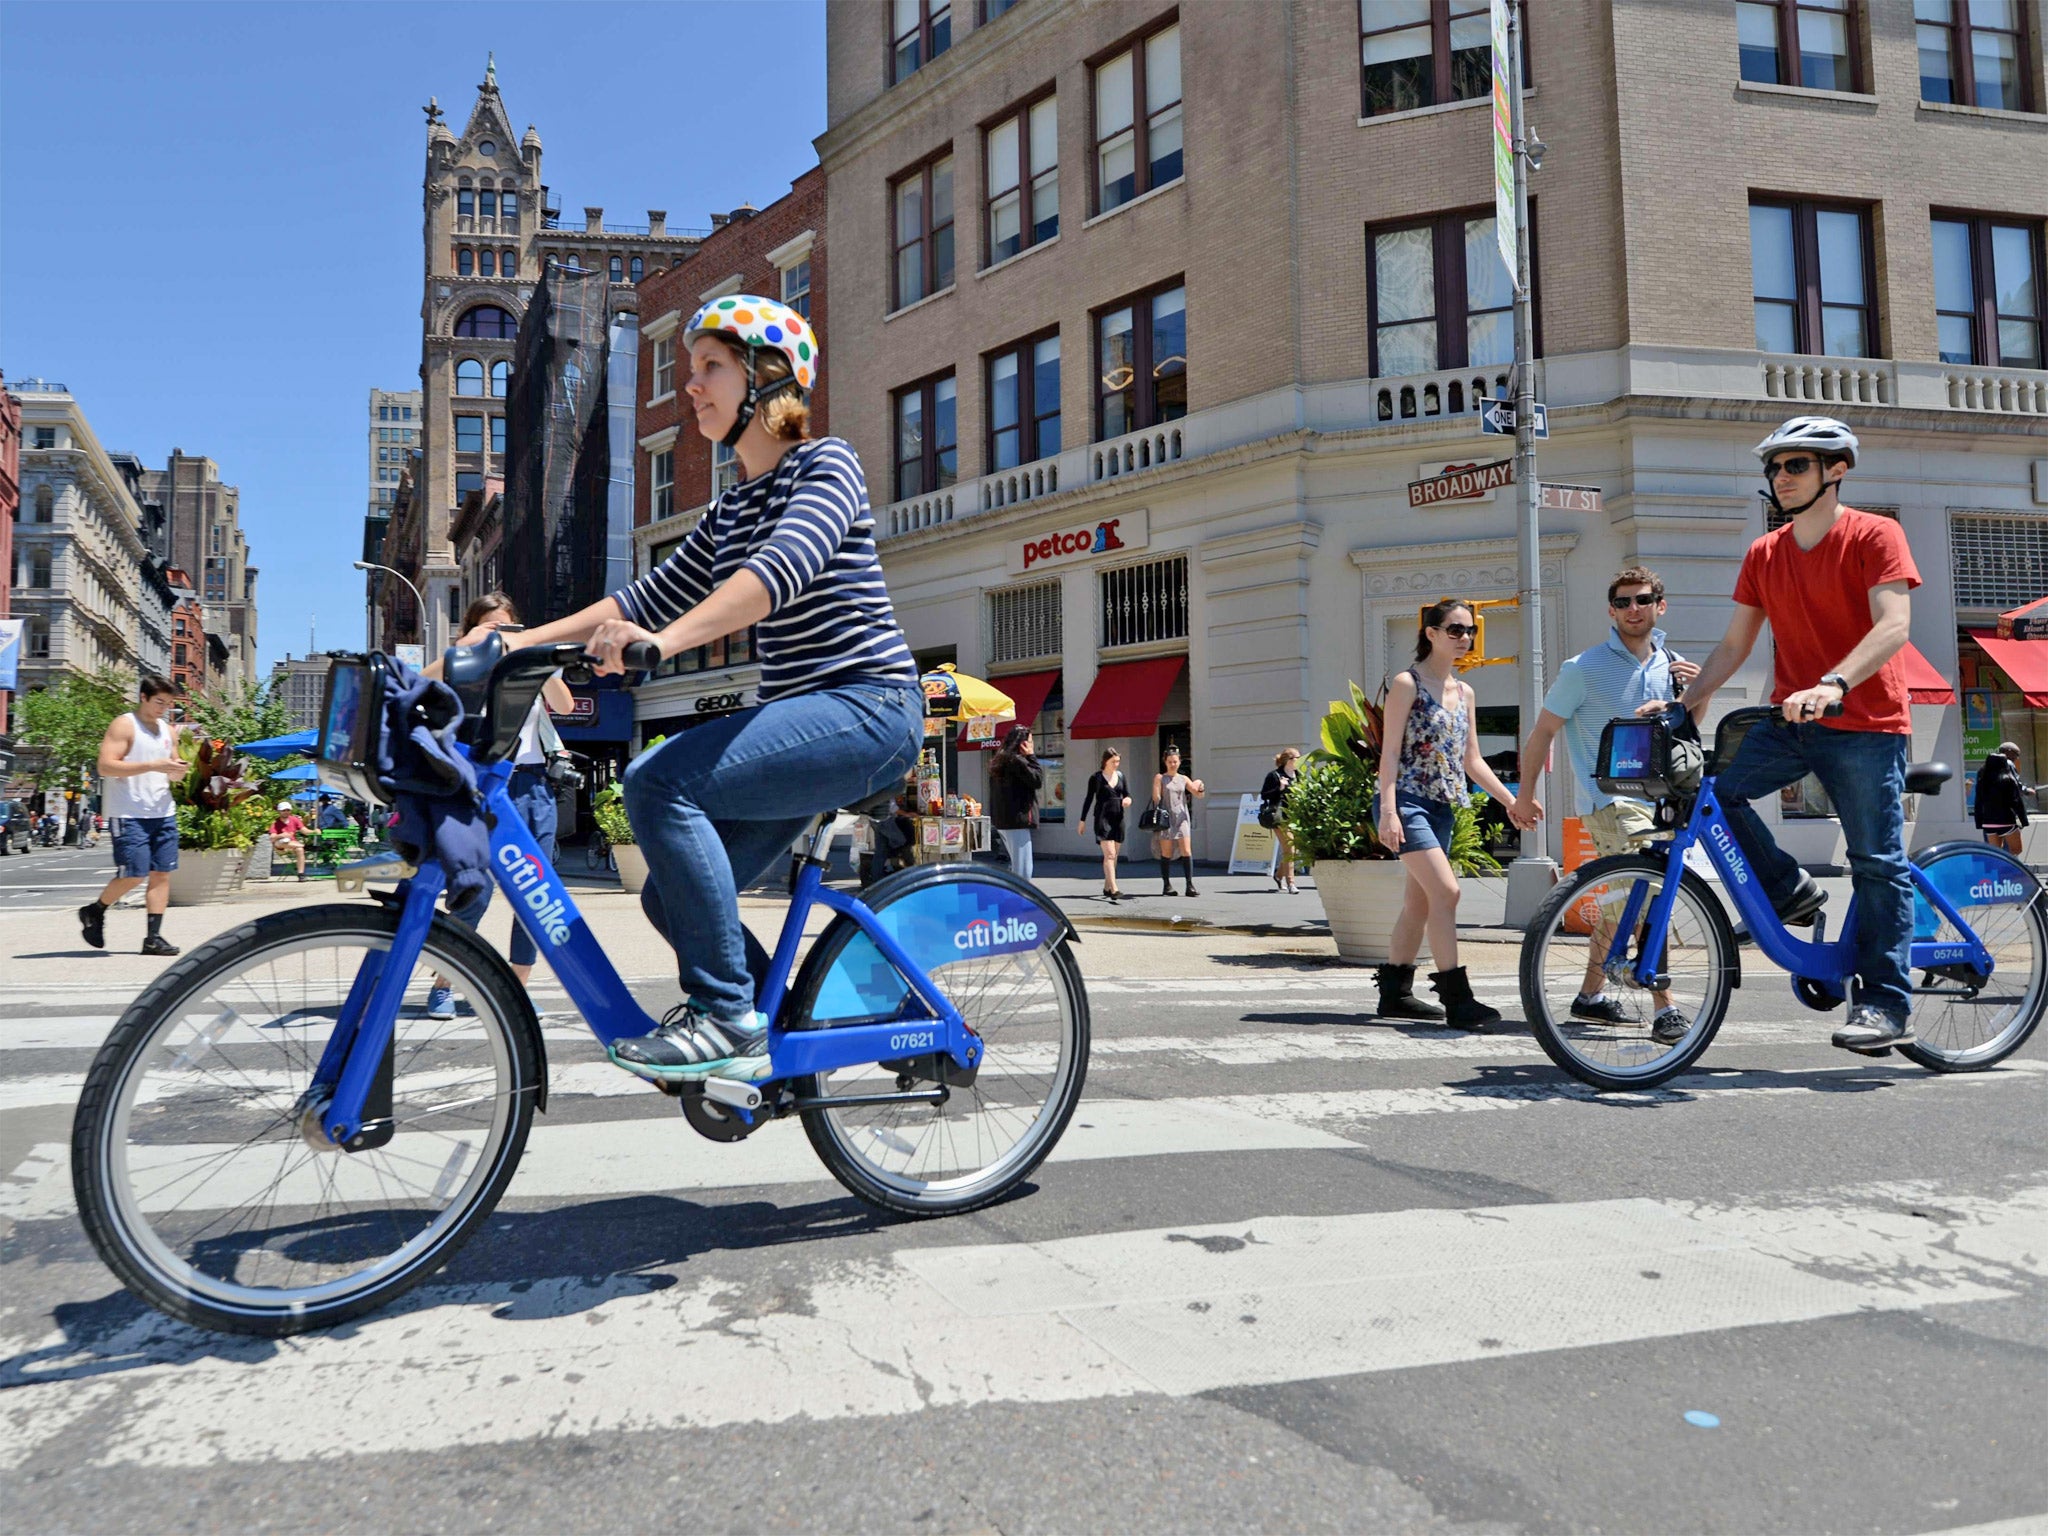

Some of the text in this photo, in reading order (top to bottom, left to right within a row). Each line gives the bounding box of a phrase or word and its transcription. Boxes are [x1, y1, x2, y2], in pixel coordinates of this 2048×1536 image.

[1494, 411, 1513, 425] ONE
[1411, 464, 1509, 505] BROADWAY
[1542, 488, 1598, 510] E 17 ST
[1023, 530, 1092, 569] petco
[695, 692, 744, 712] GEOX
[981, 739, 1001, 749] petco
[1711, 824, 1748, 885] citi bike
[498, 844, 571, 946] citi bike
[1970, 879, 2023, 898] citi bike
[954, 918, 1037, 949] citi bike
[1934, 949, 1964, 960] 05744
[890, 1032, 934, 1050] 07621
